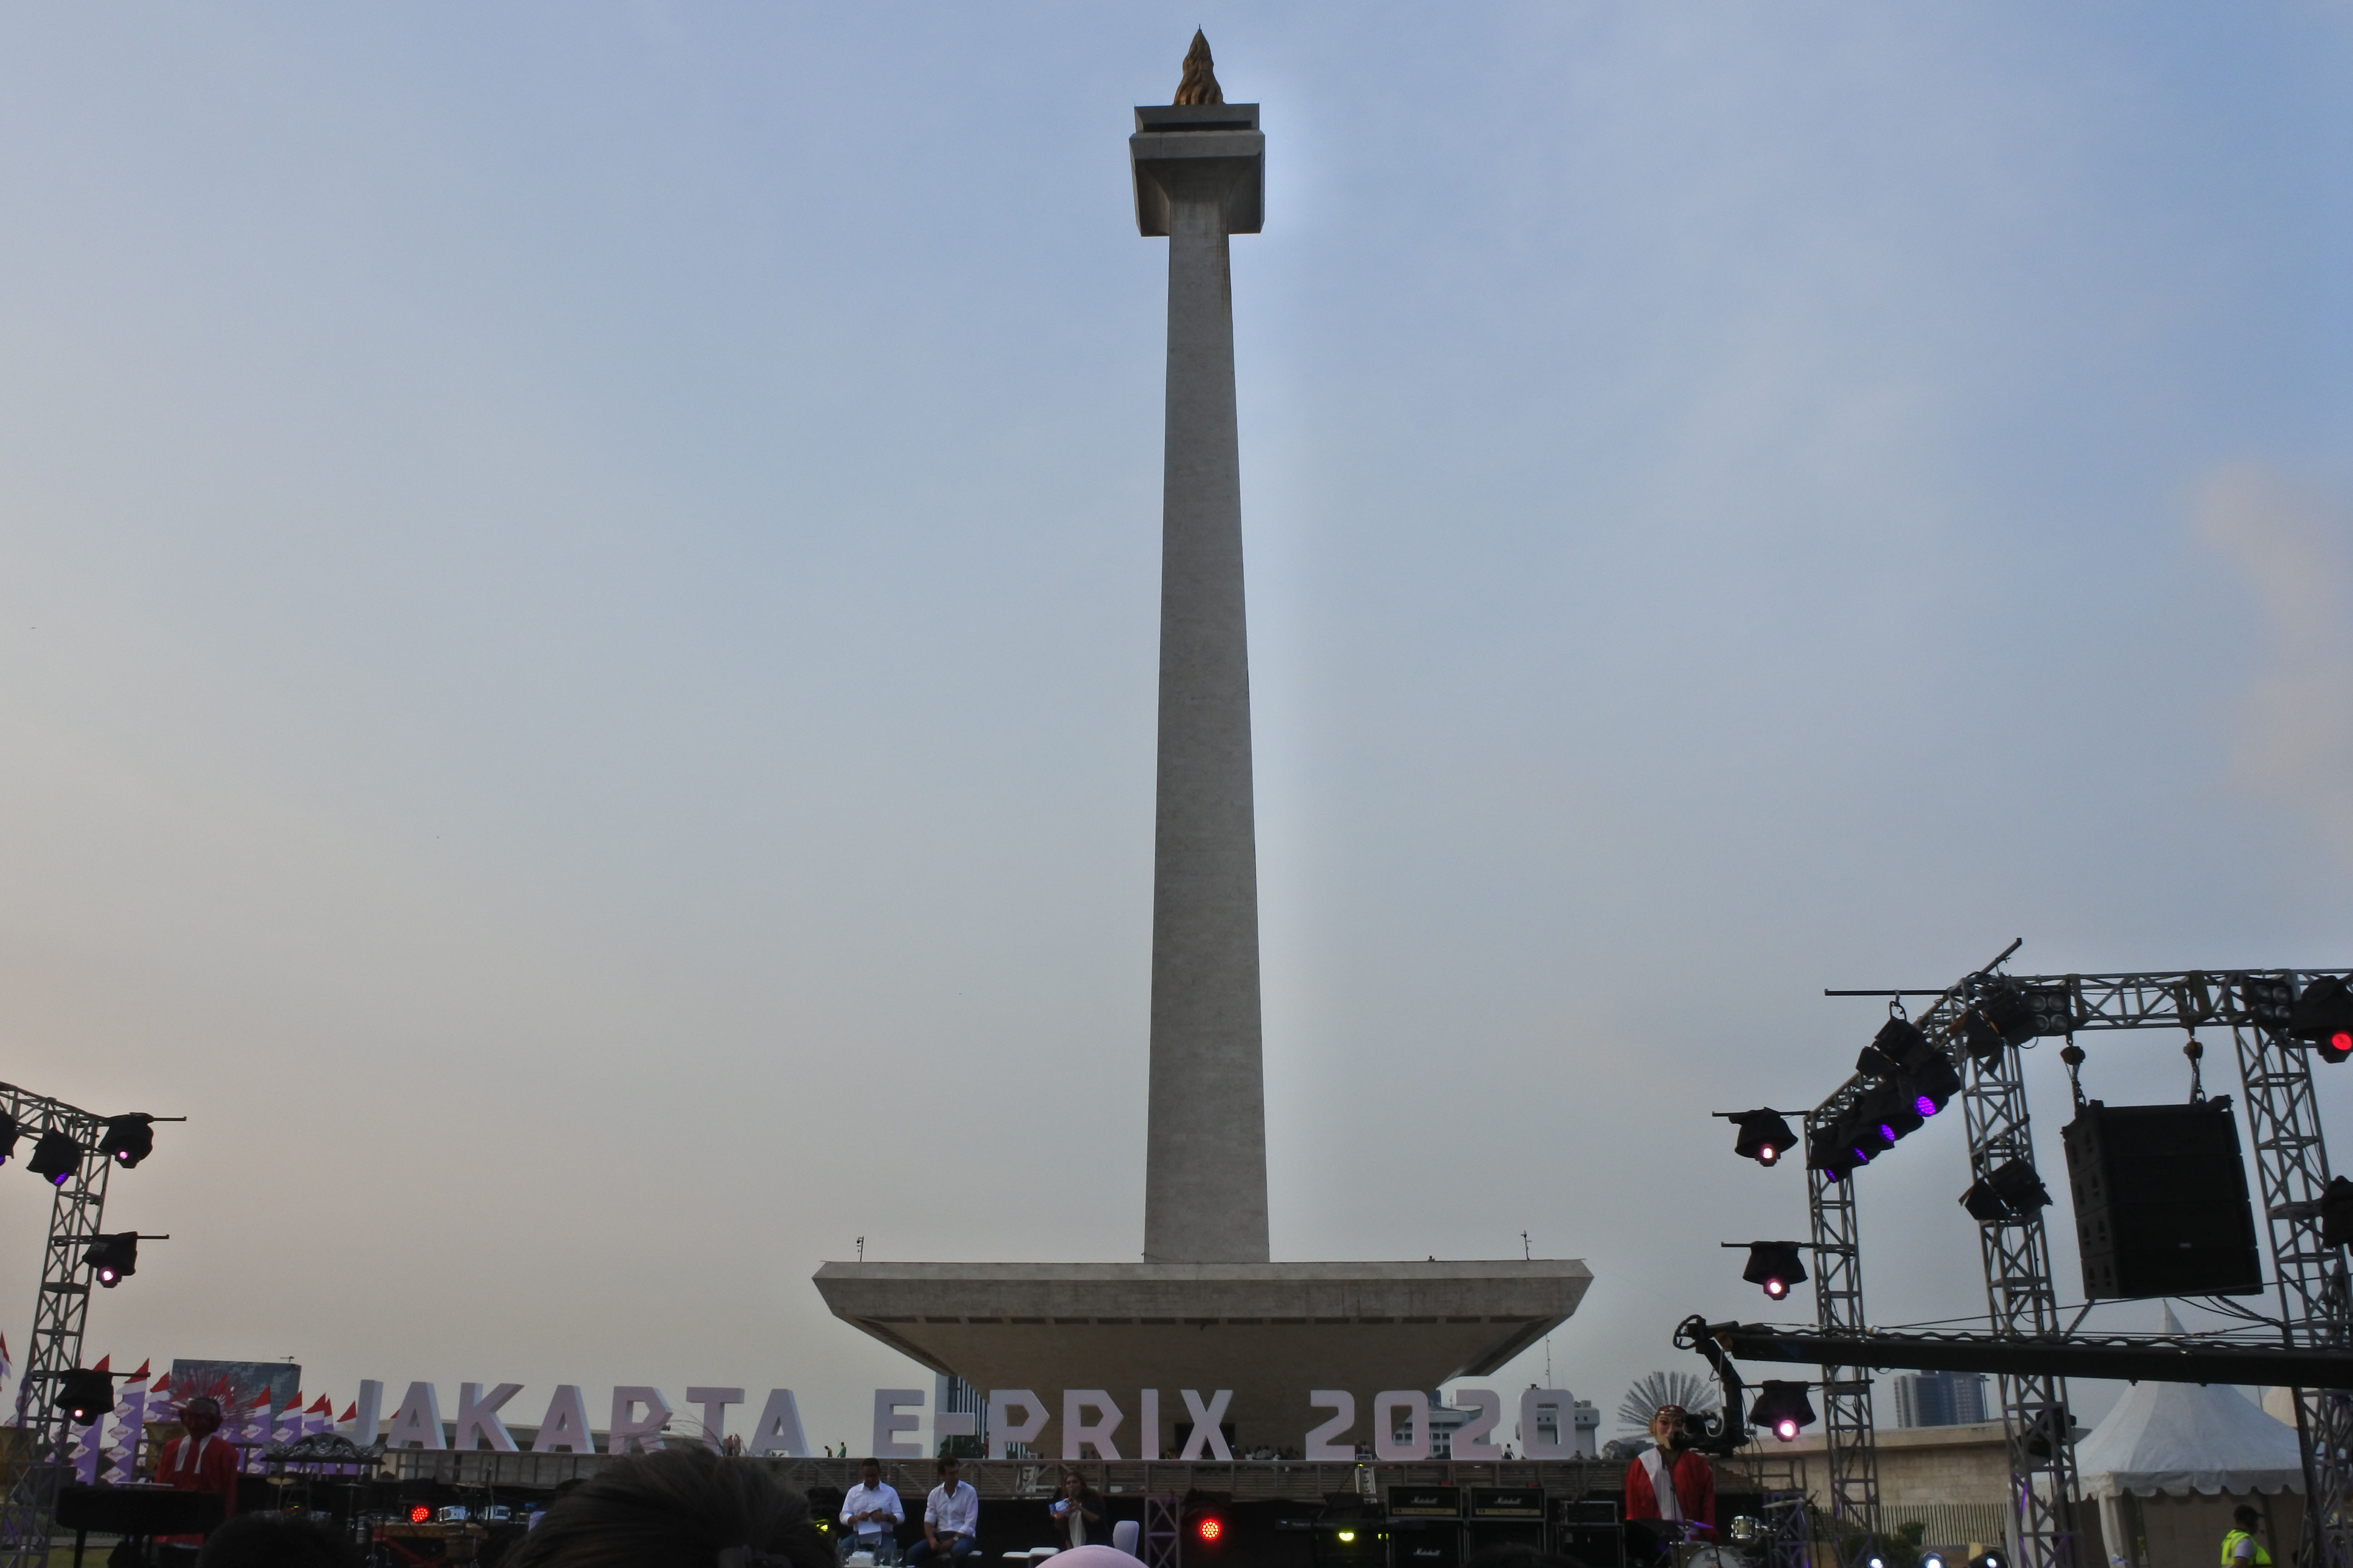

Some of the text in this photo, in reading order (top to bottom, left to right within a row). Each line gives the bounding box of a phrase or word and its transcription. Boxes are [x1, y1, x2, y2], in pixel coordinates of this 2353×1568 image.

[333, 1379, 1577, 1460] JAKARTA E-PRIX 2020
